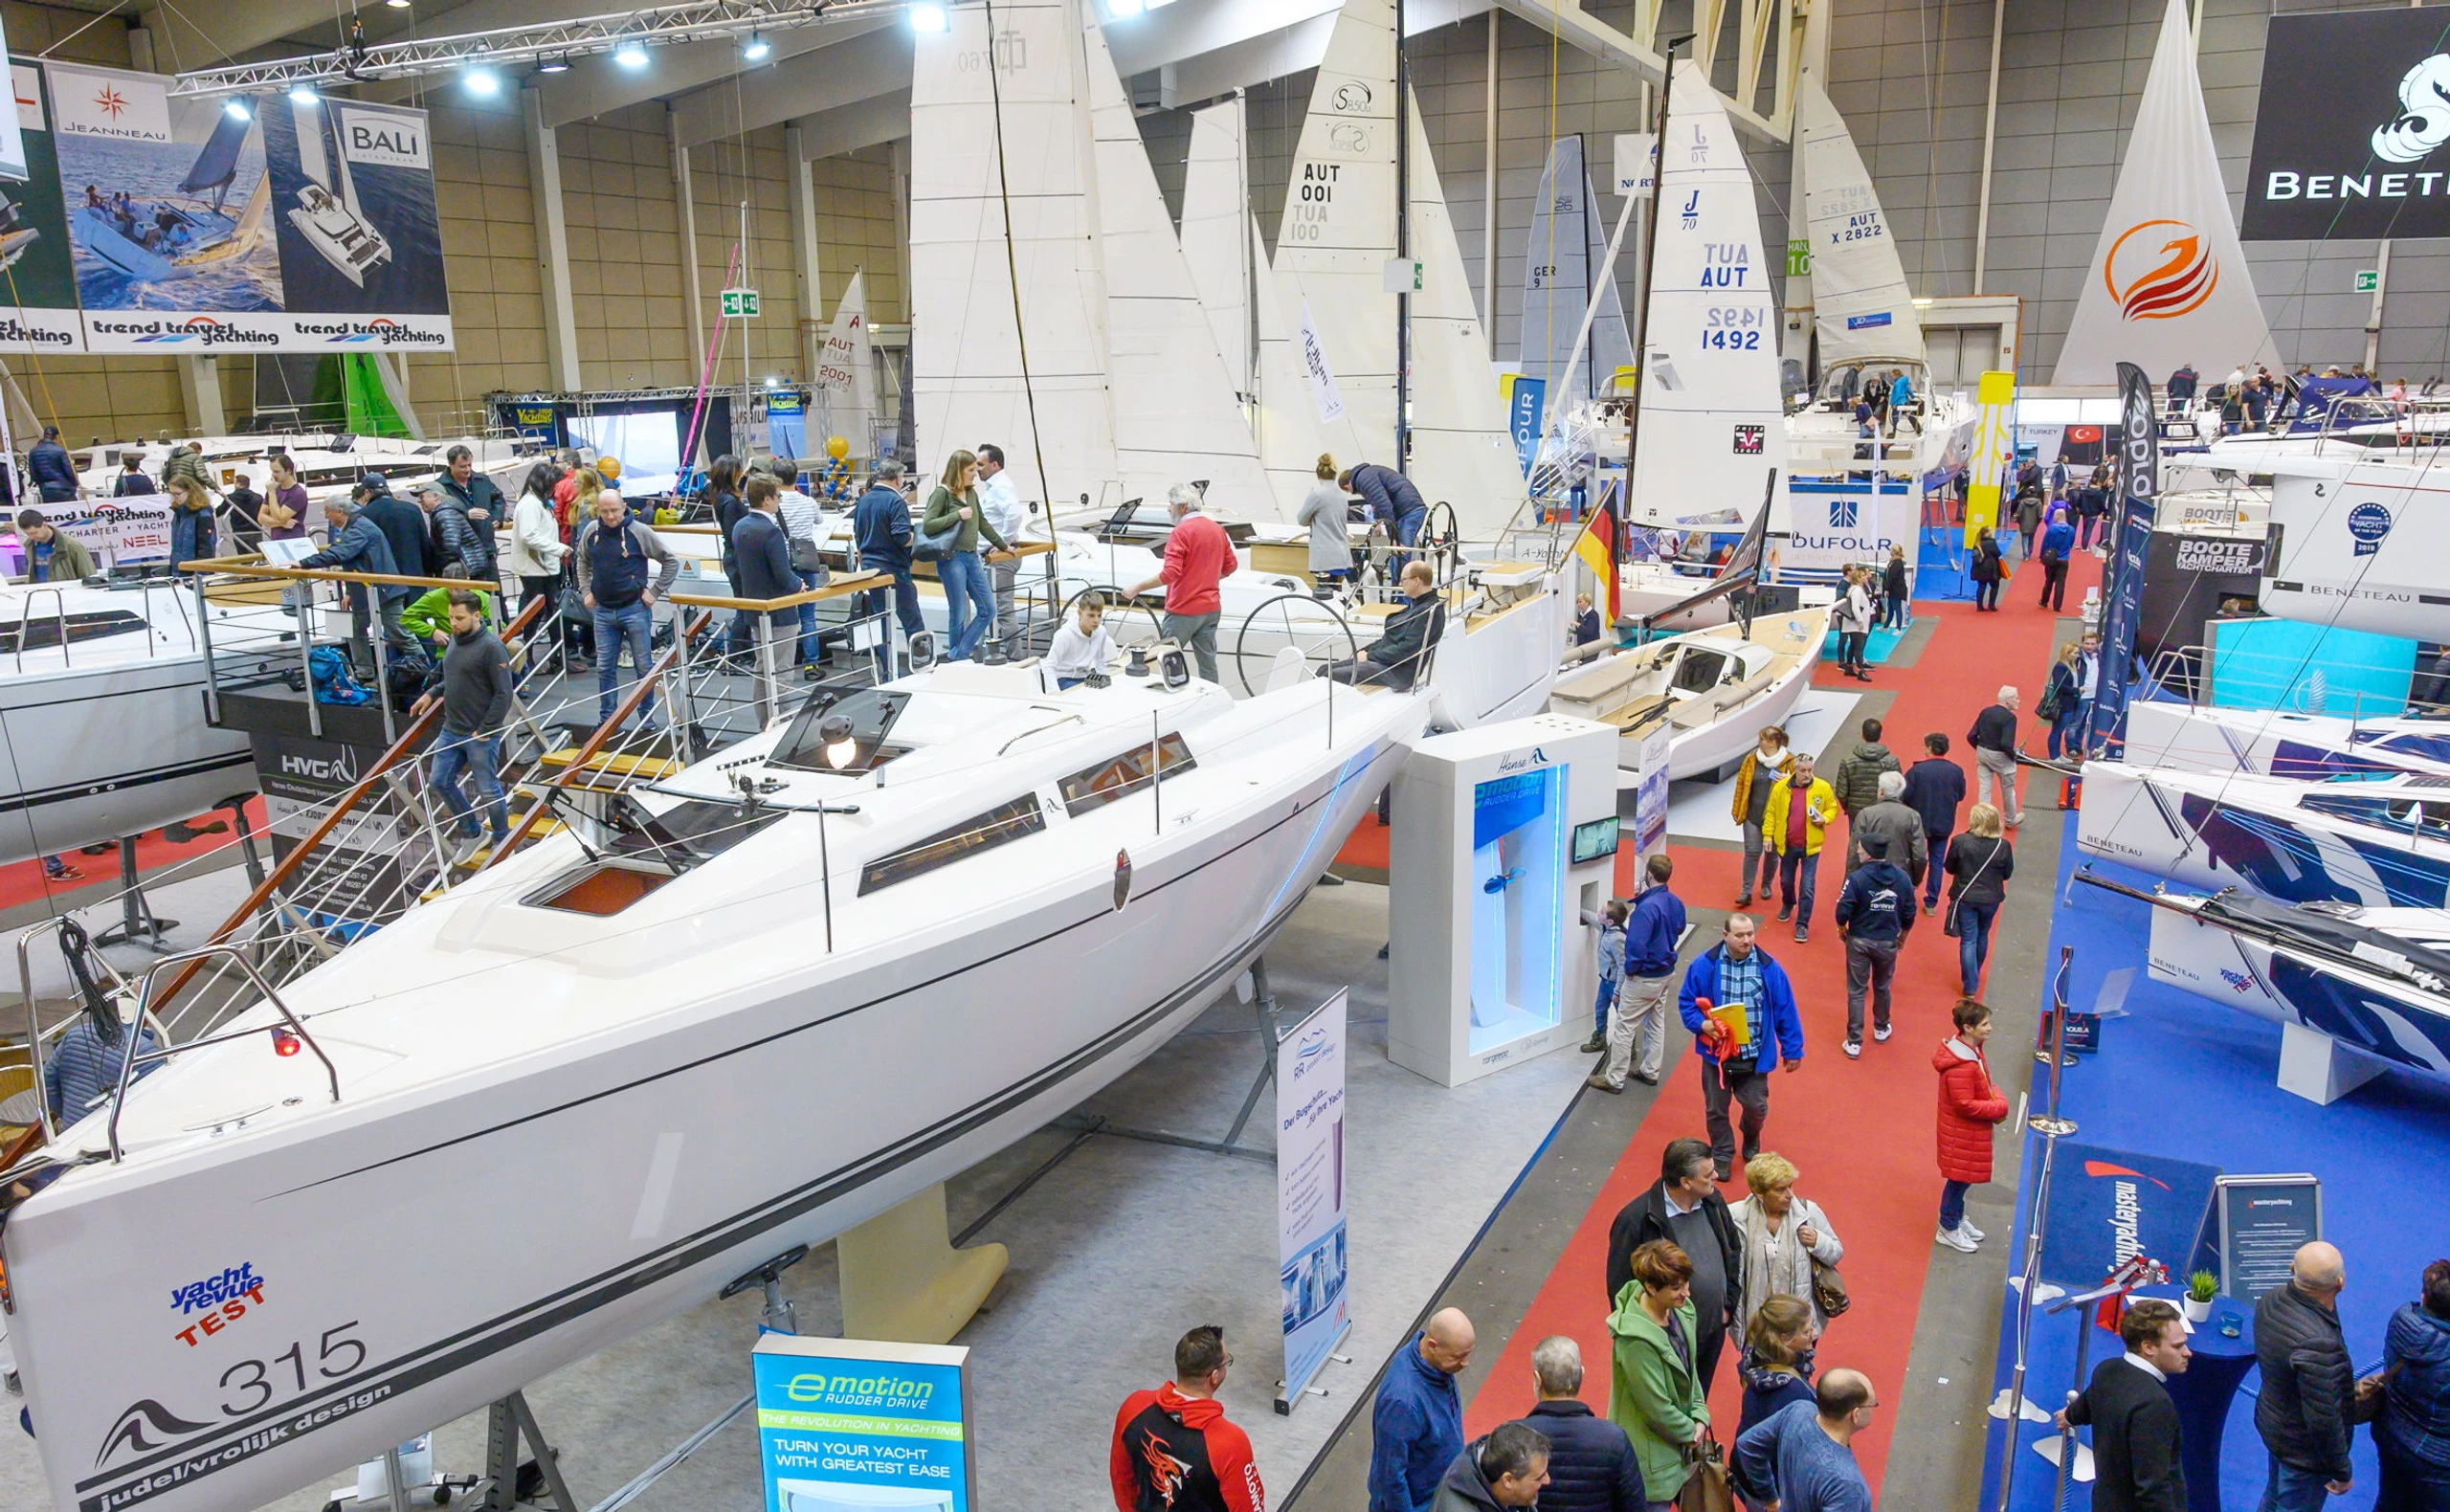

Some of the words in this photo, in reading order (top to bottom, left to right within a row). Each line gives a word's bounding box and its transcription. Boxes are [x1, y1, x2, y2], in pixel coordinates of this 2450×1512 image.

[64, 122, 166, 141] JEANNEAU
[351, 126, 418, 155] BALI
[1303, 164, 1340, 182] AUT
[2266, 171, 2450, 200] BENET
[1554, 201, 1573, 211] 26
[1684, 190, 1700, 211] J
[1682, 217, 1697, 231] 70
[1849, 212, 1877, 228] AUT
[1832, 233, 1840, 244] X
[1844, 224, 1882, 241] 2822
[1533, 265, 1557, 277] GER
[1788, 255, 1812, 276] 10
[1533, 278, 1542, 288] 9
[1701, 267, 1748, 287] AUT
[93, 320, 161, 335] trend
[167, 322, 235, 337] travel
[294, 322, 348, 334] trend
[352, 323, 408, 336] travel
[849, 315, 860, 329] A
[201, 329, 279, 345] yachting
[381, 330, 445, 345] yachting
[828, 336, 855, 353] AUT
[1703, 329, 1761, 350] 1492
[819, 365, 853, 385] 2001
[517, 409, 553, 424] YACHTING
[1516, 392, 1534, 474] UFOUR
[46, 511, 77, 523] end
[79, 506, 132, 519] travel
[106, 510, 166, 525] yachting
[2184, 507, 2236, 523] BOOTE
[2354, 520, 2383, 529] YACHT
[122, 534, 168, 549] NEEL
[1792, 535, 1892, 552] DUFOUR
[2179, 540, 2254, 557] BOOTE
[2176, 552, 2249, 567] KAMPER
[2176, 563, 2253, 574] YACHTCHARTER
[2310, 586, 2411, 603] BENETEAU
[281, 754, 329, 779] HVG
[1484, 792, 1517, 807] RUDDER
[1518, 786, 1541, 799] DRIVE
[2086, 834, 2143, 857] BENETEAU
[2153, 957, 2200, 982] BENETEAU
[2233, 974, 2257, 994] TEST
[1284, 1116, 1296, 1130] Der
[2107, 1180, 2146, 1274] masteryachti
[170, 1261, 253, 1309] yacht
[183, 1276, 265, 1315] revue
[174, 1282, 266, 1347] TEST
[219, 1320, 367, 1416] 315
[295, 1384, 391, 1433] design
[825, 1393, 882, 1407] RUDDER
[886, 1397, 929, 1410] DRIVE
[763, 1413, 787, 1424] THE
[791, 1416, 873, 1430] REVOLUTION
[877, 1422, 890, 1431] IN
[894, 1423, 961, 1435] YACHTING
[774, 1438, 819, 1454] TURN
[822, 1442, 869, 1456] YOUR
[873, 1446, 928, 1460] YACHT
[775, 1454, 817, 1469] WITH
[821, 1458, 904, 1475] GREATEST
[908, 1464, 951, 1479] EASE
